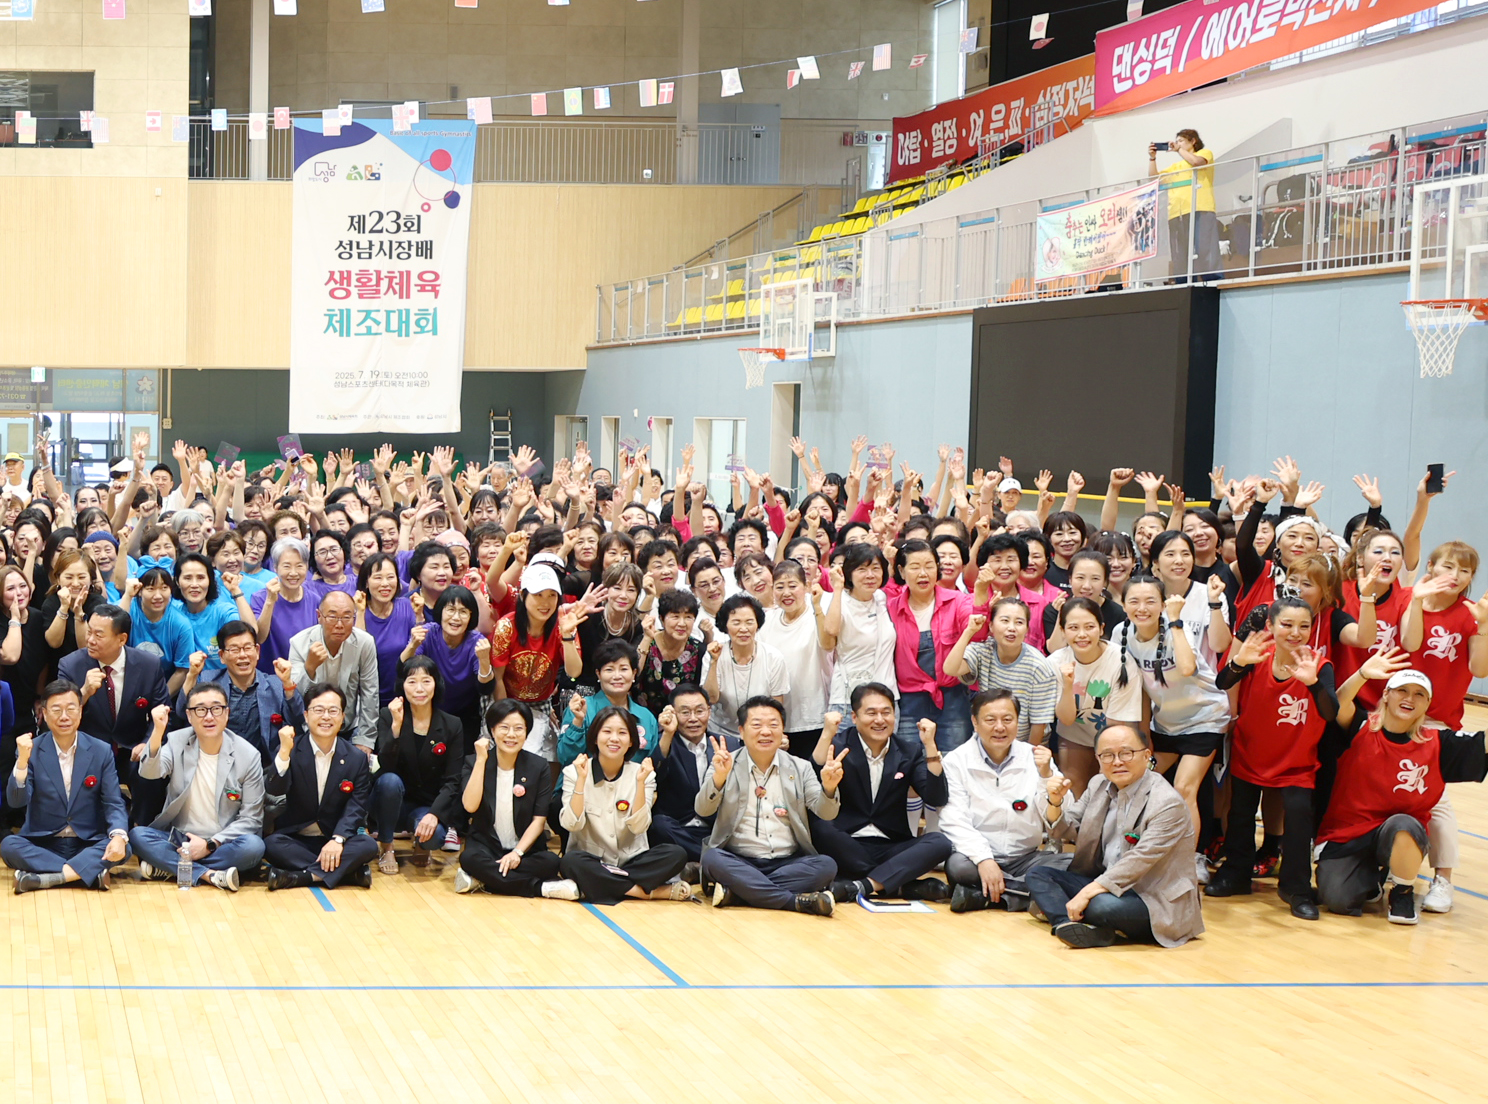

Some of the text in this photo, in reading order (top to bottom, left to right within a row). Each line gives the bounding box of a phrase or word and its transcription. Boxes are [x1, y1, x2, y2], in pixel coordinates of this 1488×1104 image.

[1112, 26, 1180, 93] 댄싱덕
[347, 211, 422, 235] 제23회
[334, 239, 434, 261] 성남시장배
[324, 270, 441, 300] 생활체육
[323, 308, 438, 338] 체조대회
